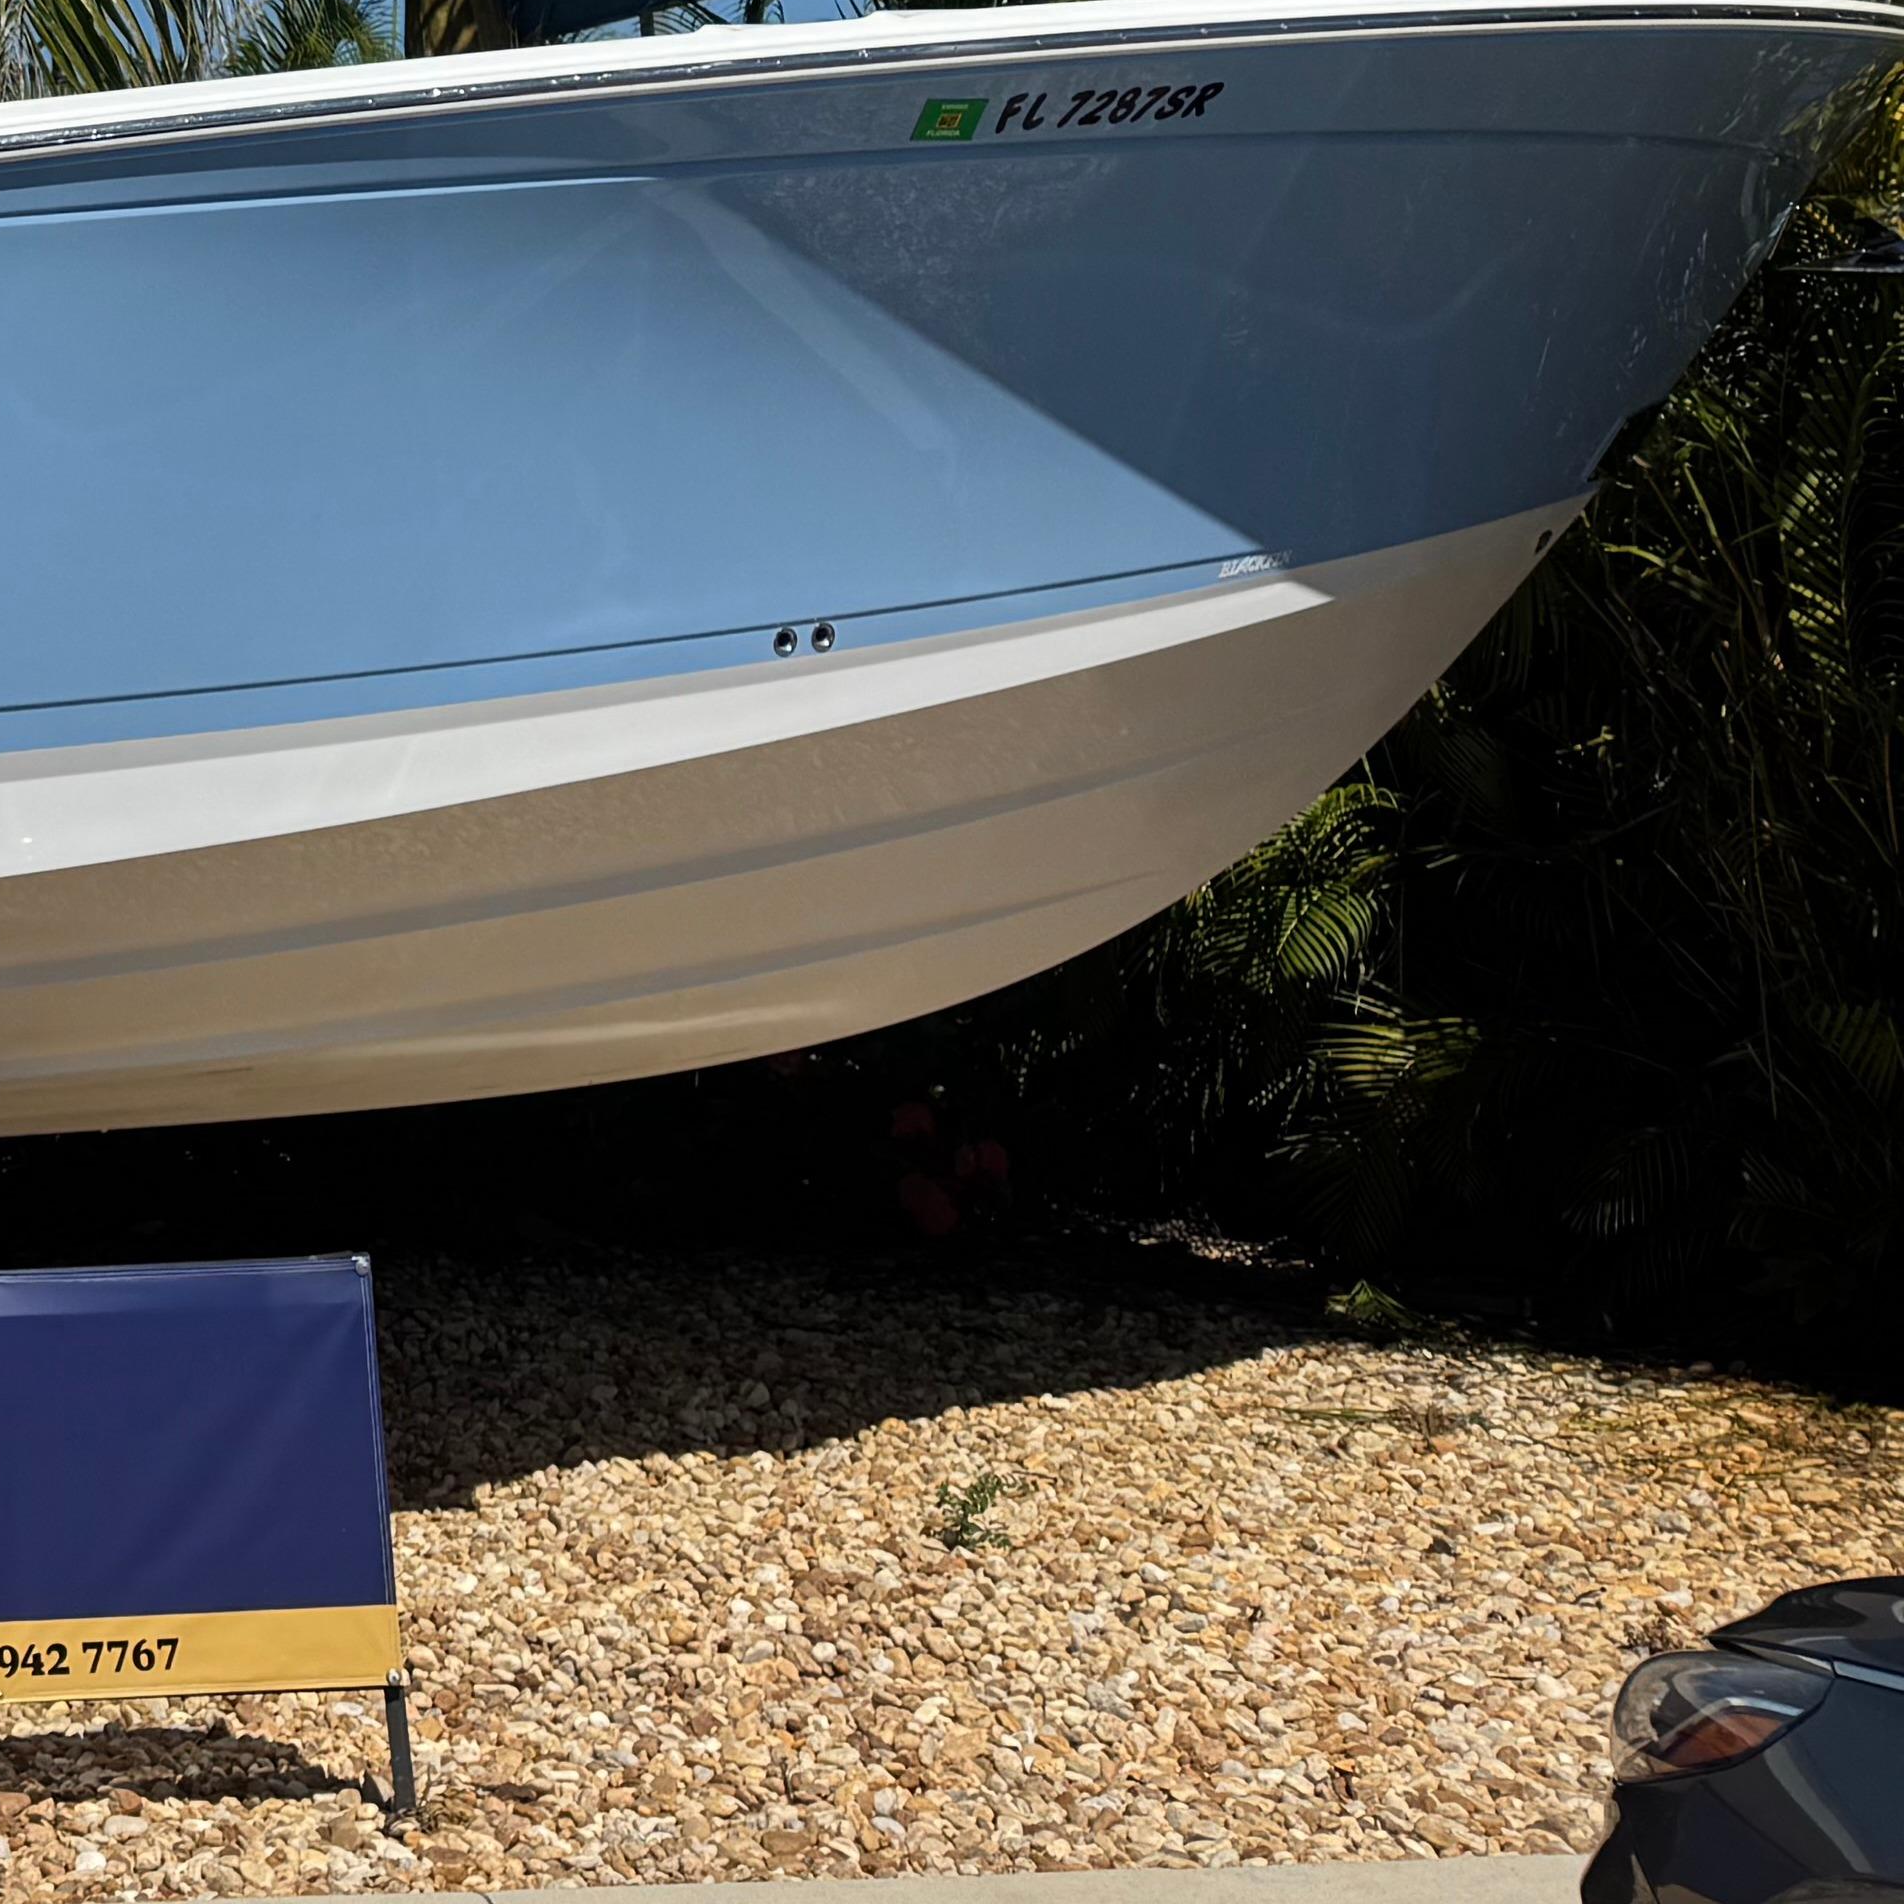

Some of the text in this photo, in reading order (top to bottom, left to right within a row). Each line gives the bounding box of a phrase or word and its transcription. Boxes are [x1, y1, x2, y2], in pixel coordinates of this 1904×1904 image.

[995, 81, 1225, 135] FL 7287SR
[81, 1637, 181, 1674] 7767
